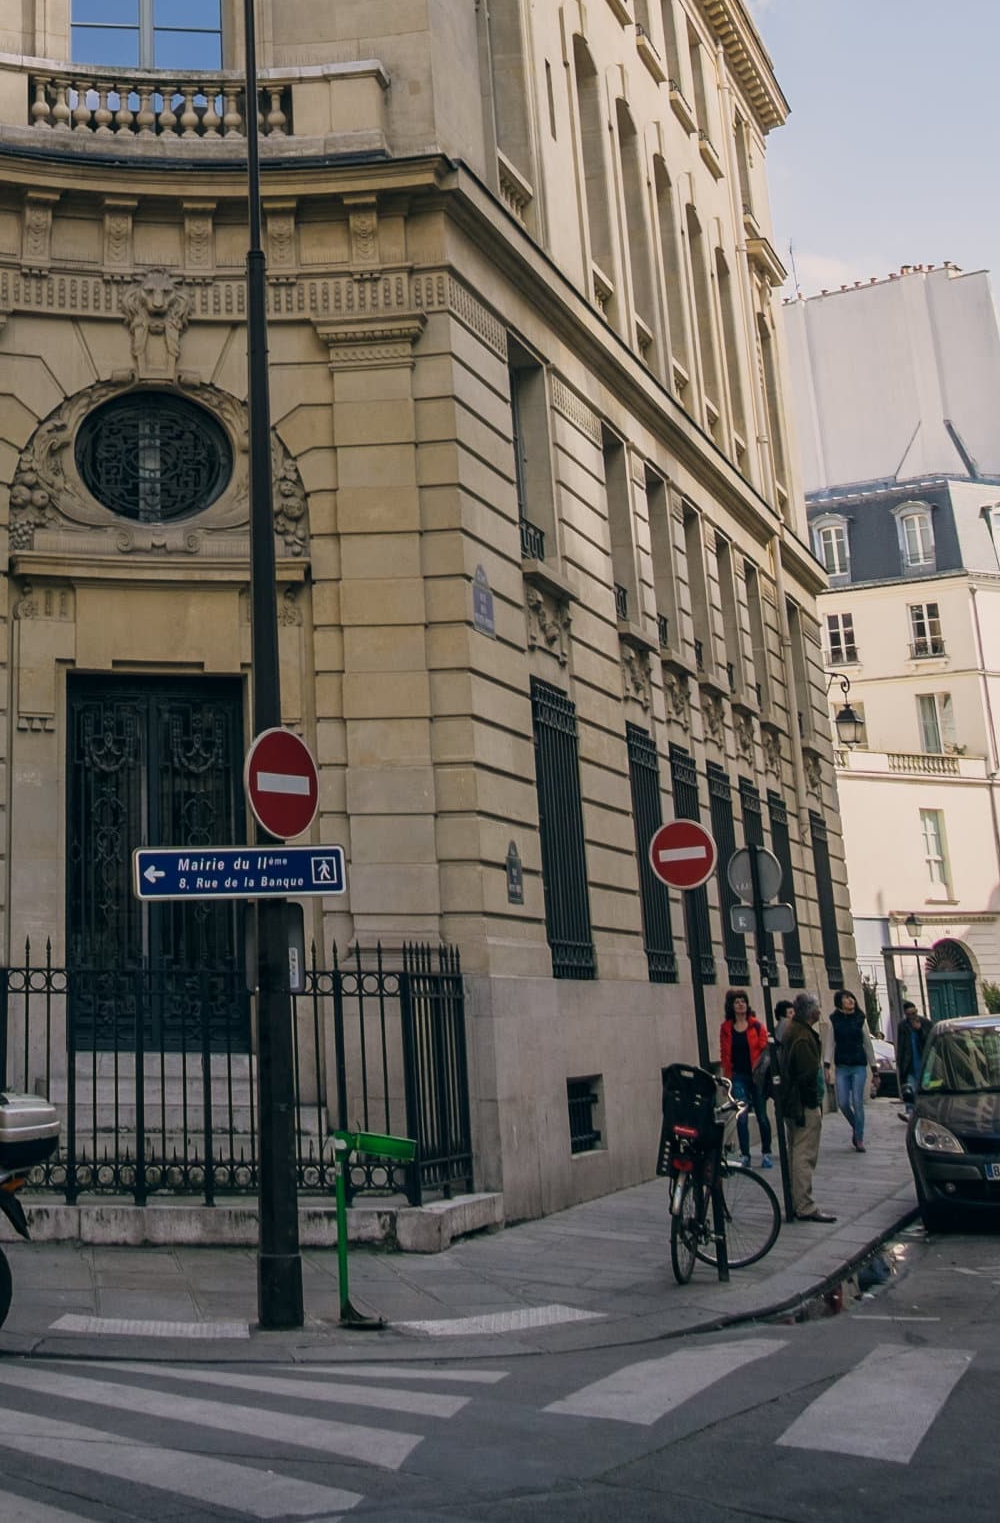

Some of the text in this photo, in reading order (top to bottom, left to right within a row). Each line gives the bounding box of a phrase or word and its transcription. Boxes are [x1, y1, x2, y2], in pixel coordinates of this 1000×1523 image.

[178, 857, 225, 871] Mairie
[233, 857, 250, 870] du
[196, 877, 218, 889] Rue
[224, 876, 238, 888] de
[244, 876, 255, 888] la
[261, 876, 304, 889] Banque
